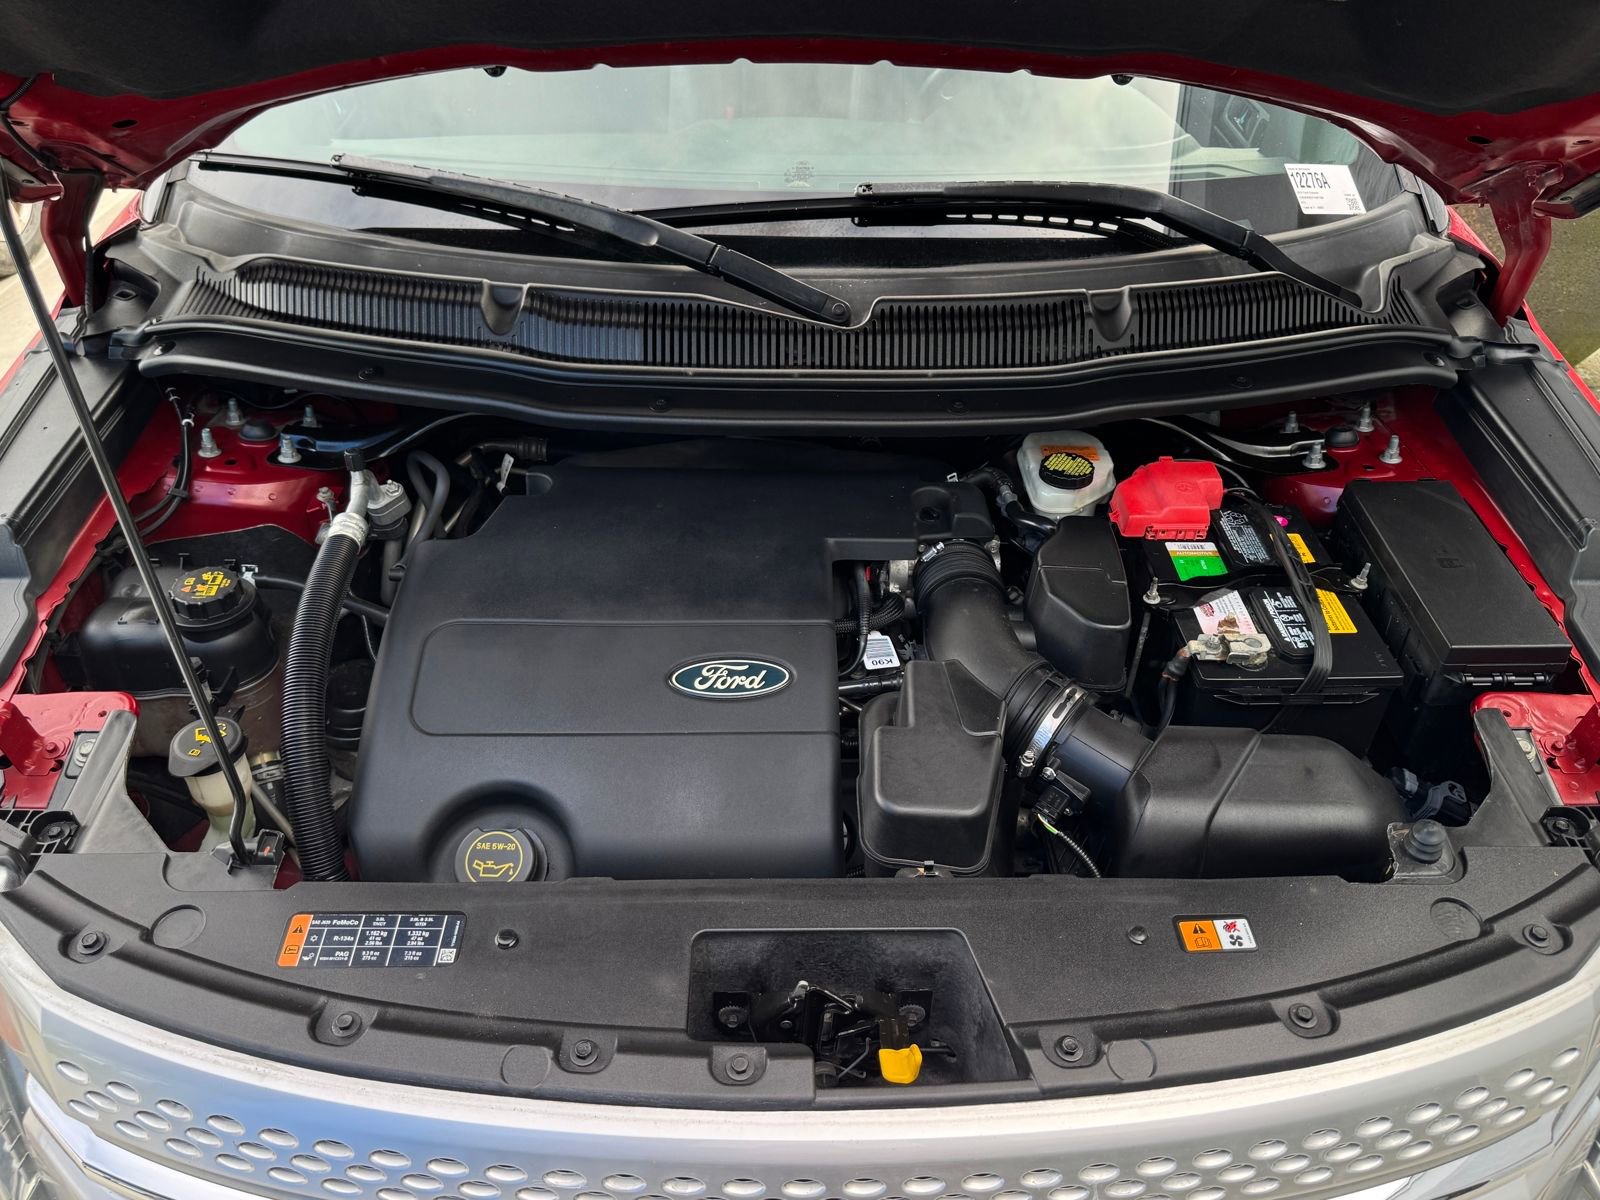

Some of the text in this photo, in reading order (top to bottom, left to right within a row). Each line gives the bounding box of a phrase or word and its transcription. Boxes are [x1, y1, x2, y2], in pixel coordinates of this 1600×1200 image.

[1290, 172, 1331, 189] 12276A
[871, 658, 893, 666] K90
[694, 664, 768, 690] Ford
[475, 842, 516, 851] SAE 5W-20
